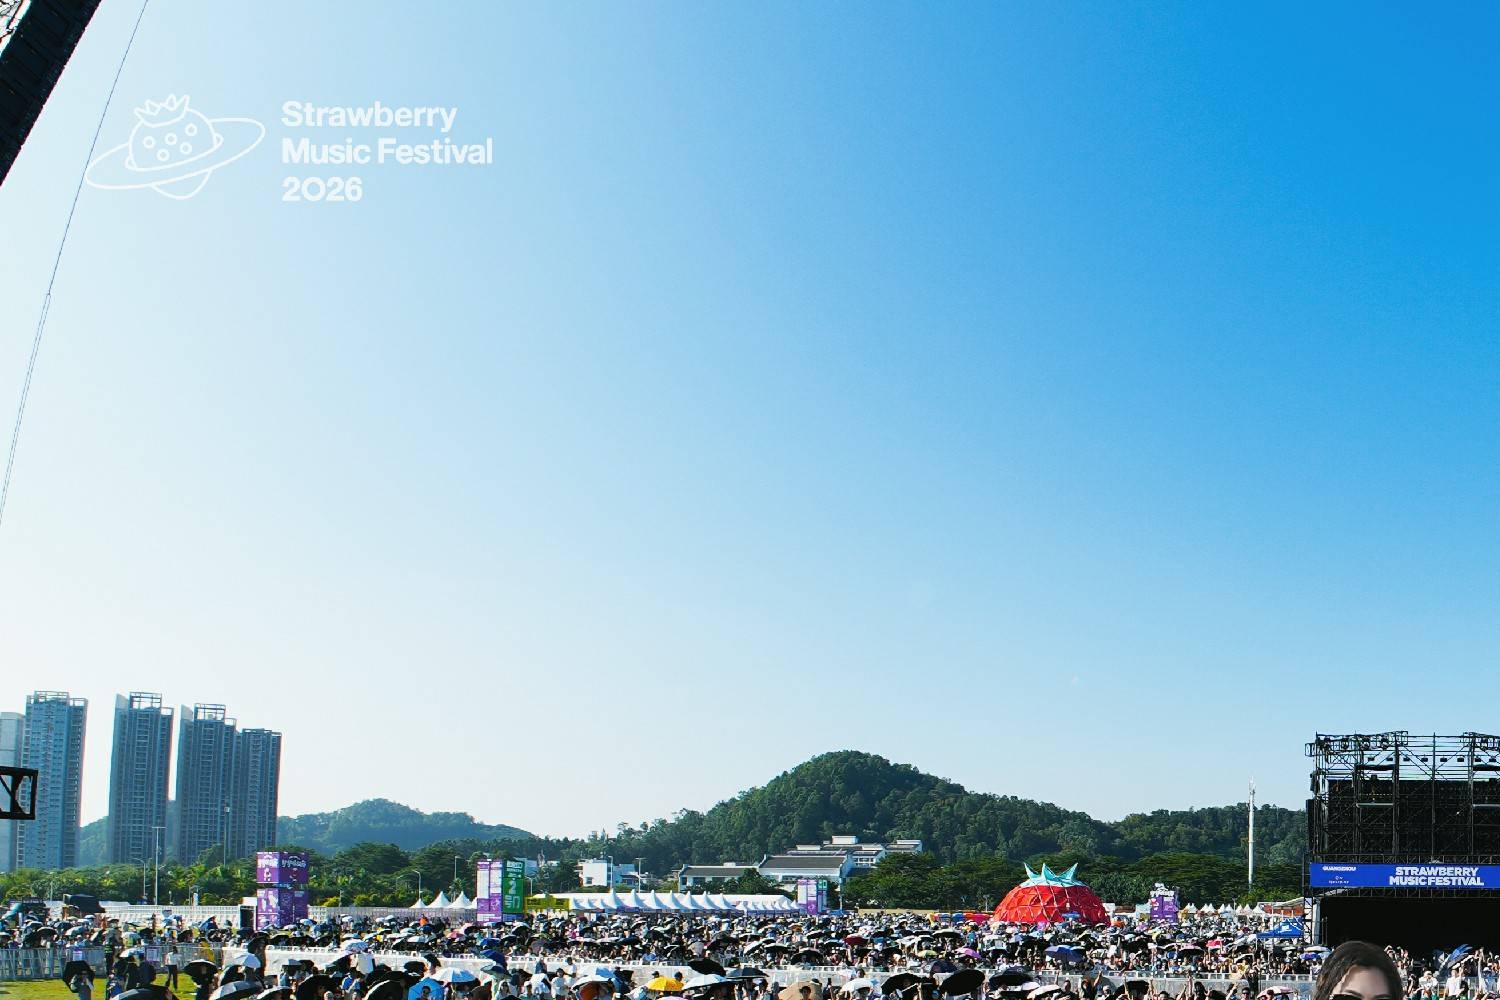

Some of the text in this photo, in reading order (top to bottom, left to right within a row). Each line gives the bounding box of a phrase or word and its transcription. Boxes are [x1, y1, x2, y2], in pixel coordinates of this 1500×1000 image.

[1395, 866, 1479, 876] STRAWBERRY
[1389, 876, 1485, 886] MUSIC FESTIVAL
